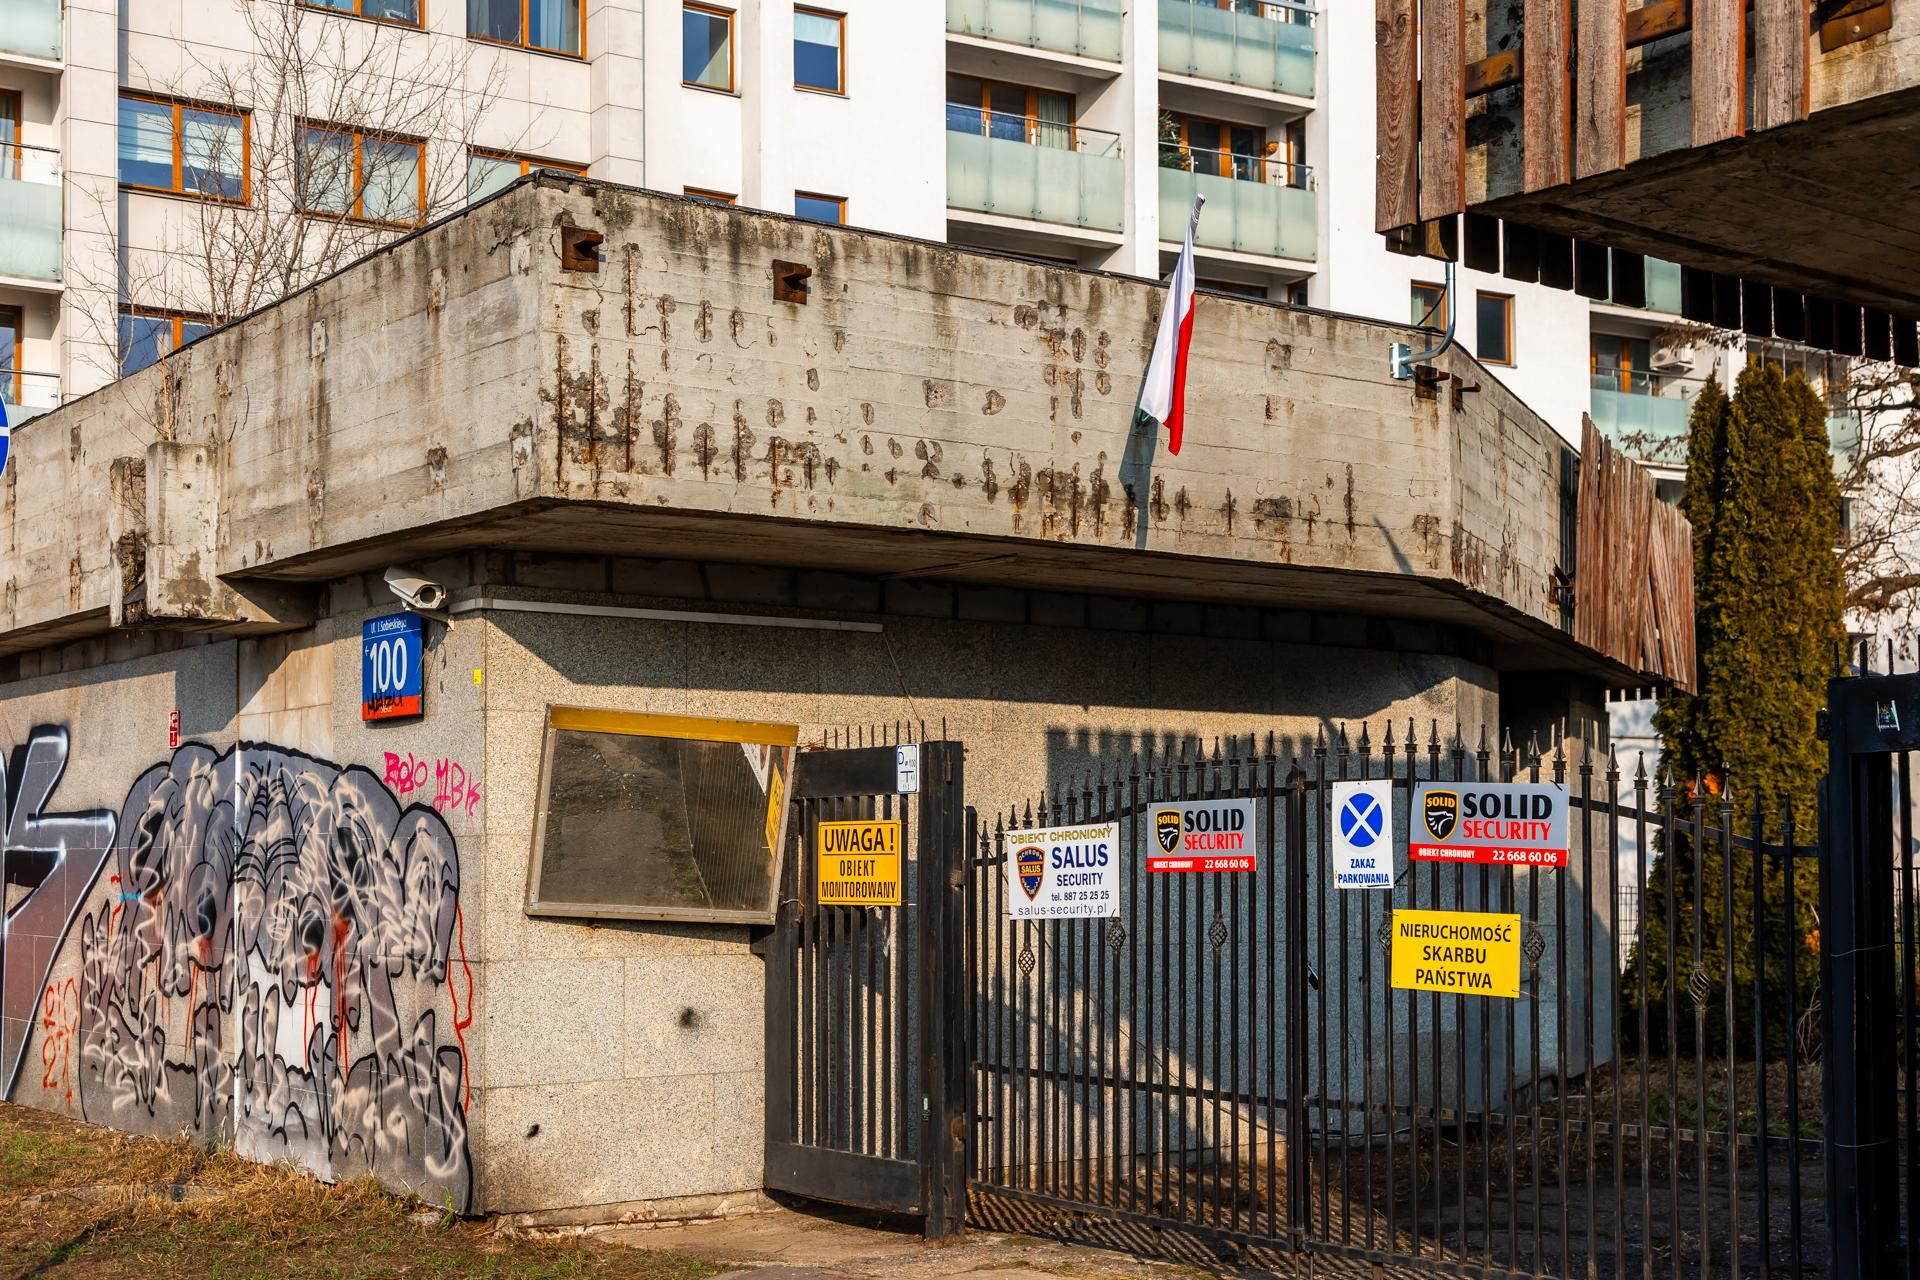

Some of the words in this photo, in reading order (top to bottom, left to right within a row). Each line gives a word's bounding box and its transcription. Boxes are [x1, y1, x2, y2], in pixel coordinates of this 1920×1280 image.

[369, 637, 408, 693] 100
[1426, 796, 1455, 808] SOLID
[1463, 792, 1553, 820] SOLID
[1158, 815, 1179, 825] SOLID
[1184, 808, 1245, 832] SOLID
[1010, 832, 1047, 844] OBIEKT
[1049, 827, 1113, 842] CHRONIONY
[1463, 820, 1552, 841] SECURITY
[1184, 832, 1245, 850] SECURITY
[1051, 843, 1109, 869] SALUS
[1418, 847, 1439, 857] OBIEKT
[1440, 849, 1475, 859] CHRONIONY
[1492, 850, 1505, 861] 22
[1506, 851, 1526, 861] 668
[1528, 852, 1542, 862] 60
[1543, 852, 1557, 863] 06
[839, 859, 875, 877] OBIEKT
[1021, 865, 1041, 873] SALUS
[1204, 860, 1214, 869] 22
[1214, 859, 1228, 868] 668
[1229, 859, 1239, 868] 60
[1239, 859, 1250, 868] 06
[1350, 858, 1376, 869] ZAKAZ
[1056, 872, 1103, 887] SECURITY
[1338, 873, 1390, 884] PARKOWANIA
[821, 881, 896, 898] MONITOROWANY
[1051, 893, 1062, 901] tel.
[1063, 892, 1077, 901] 887
[1079, 891, 1088, 900] 25
[1089, 891, 1099, 900] 25
[1100, 890, 1110, 899] 25
[1018, 903, 1107, 916] salus-security.pl
[1400, 923, 1511, 942] NIERUCHOMOŚĆ
[1423, 945, 1487, 964] SKARBU
[1415, 966, 1493, 989] PAŃSTWA
